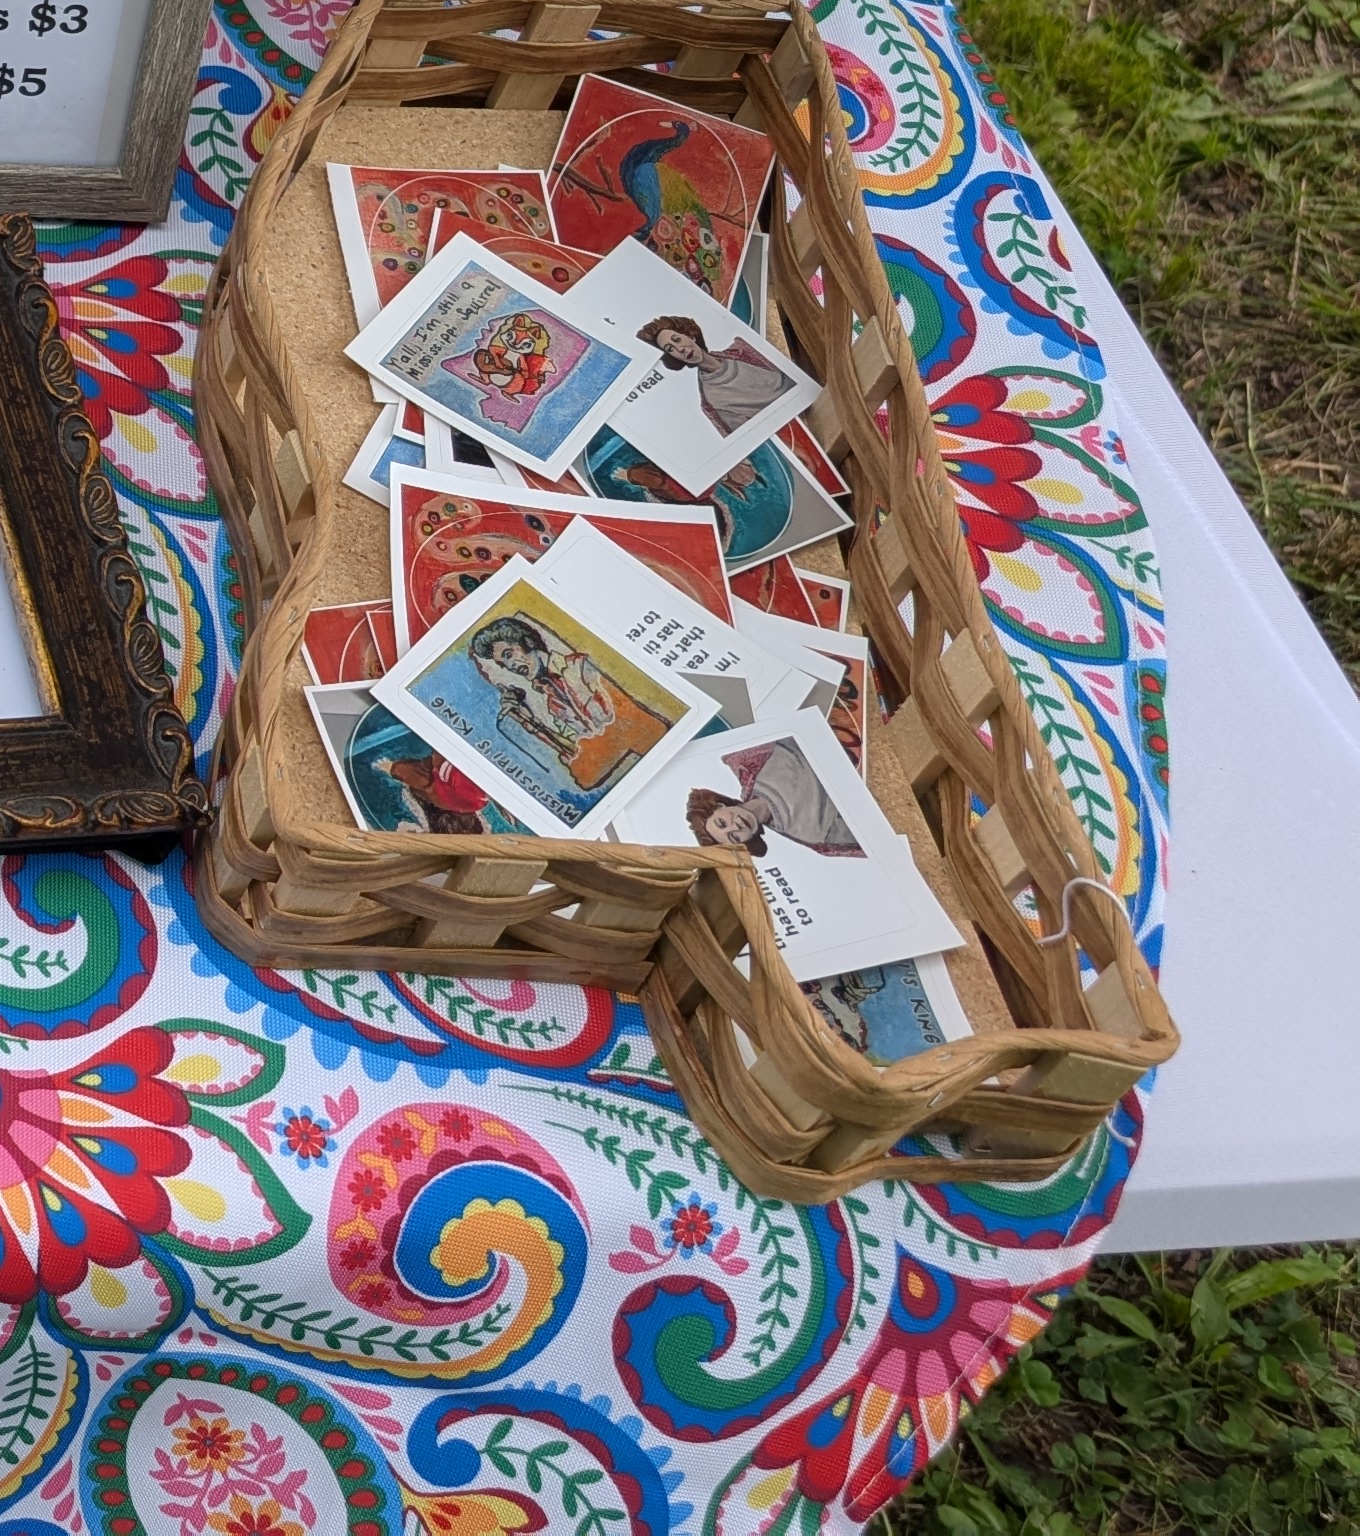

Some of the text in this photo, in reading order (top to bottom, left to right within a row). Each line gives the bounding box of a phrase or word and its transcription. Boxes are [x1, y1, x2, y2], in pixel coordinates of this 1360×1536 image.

[28, 0, 89, 38] $3
[406, 279, 502, 381] Mississippi Squirrel
[636, 371, 665, 397] read
[643, 610, 662, 625] to
[656, 618, 685, 642] has
[680, 625, 706, 653] that
[430, 696, 582, 825] MISSISSIPPI'S KING
[764, 866, 800, 905] read
[773, 906, 800, 937] has
[795, 907, 813, 926] to
[910, 997, 941, 1045] KING
